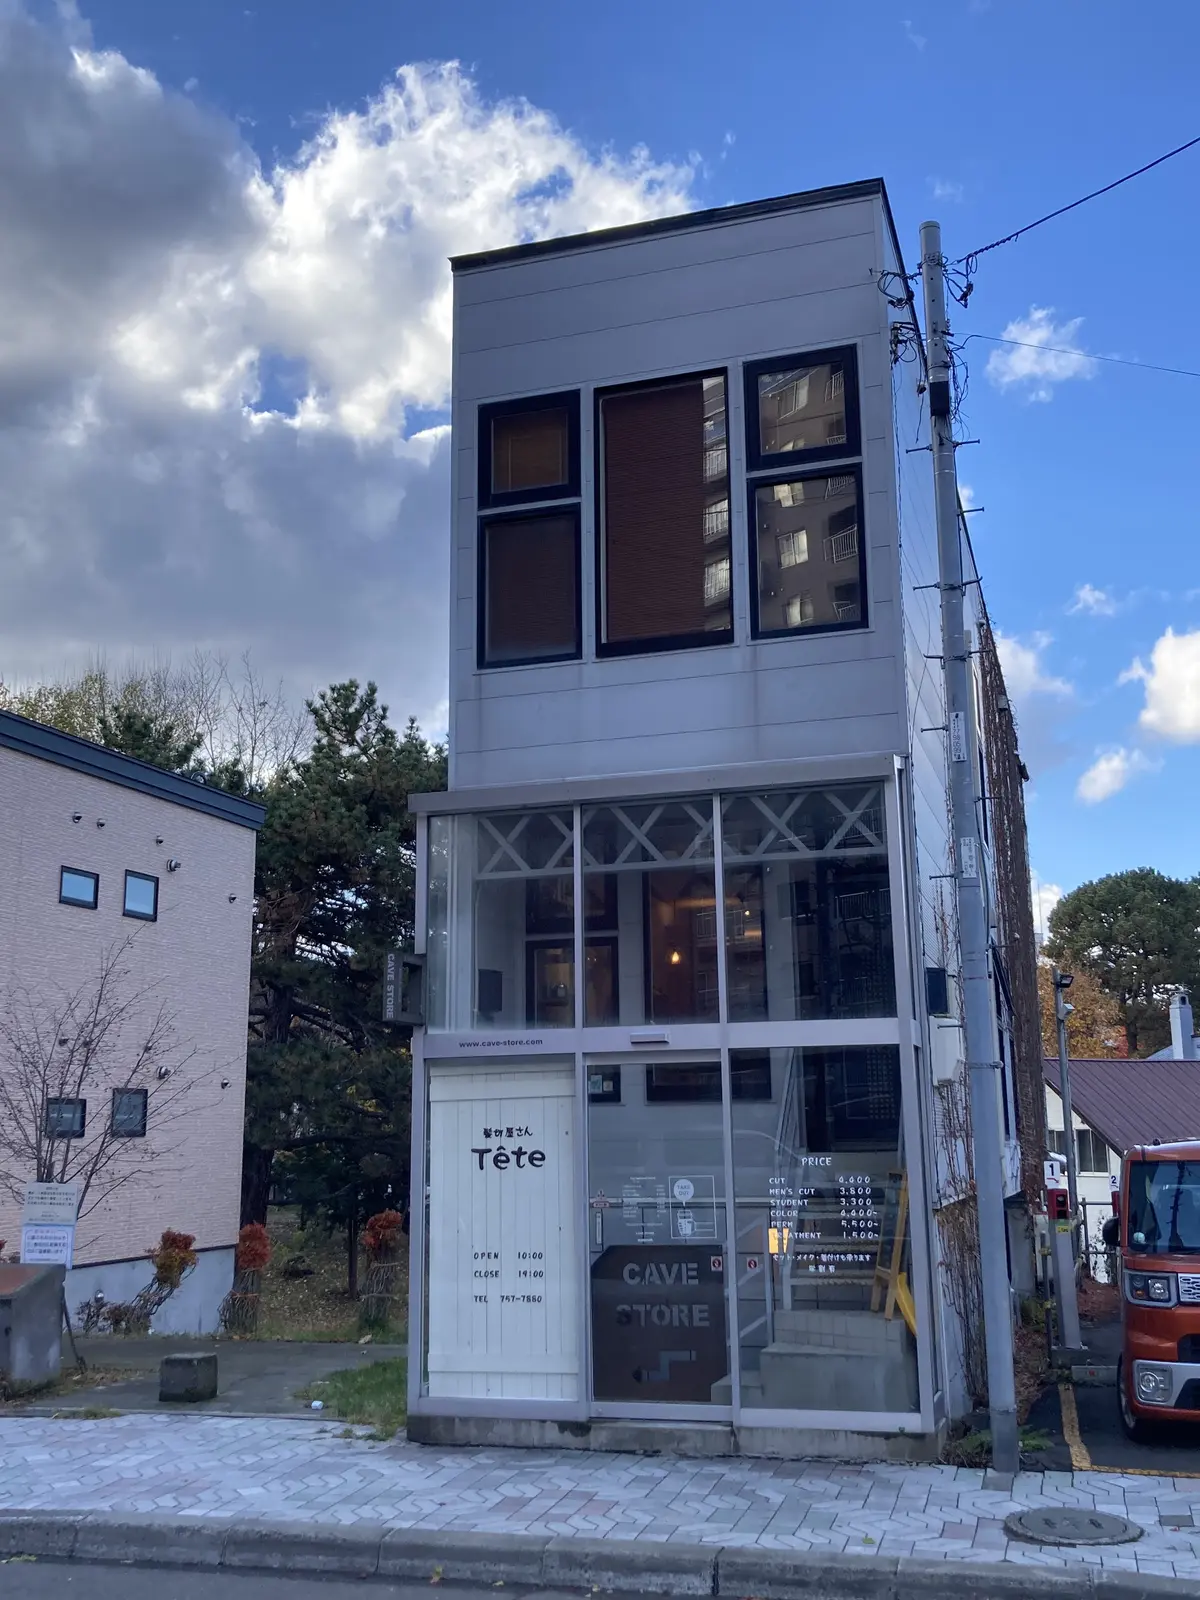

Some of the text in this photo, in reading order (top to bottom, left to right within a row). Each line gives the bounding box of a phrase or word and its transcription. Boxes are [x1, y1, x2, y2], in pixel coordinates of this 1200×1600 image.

[386, 953, 395, 1019] CAVE STORE
[459, 1039, 543, 1048] www.cave-store.com
[471, 1145, 546, 1171] Tête
[801, 1157, 832, 1166] PRICE
[1049, 1163, 1054, 1176] 1
[1110, 1176, 1117, 1184] 2
[769, 1187, 793, 1195] MEN'S
[474, 1270, 544, 1278] CLOSE 19:00
[622, 1262, 699, 1285] CAVE
[474, 1295, 542, 1303] TEL 757-7880
[616, 1304, 710, 1327] STORE
